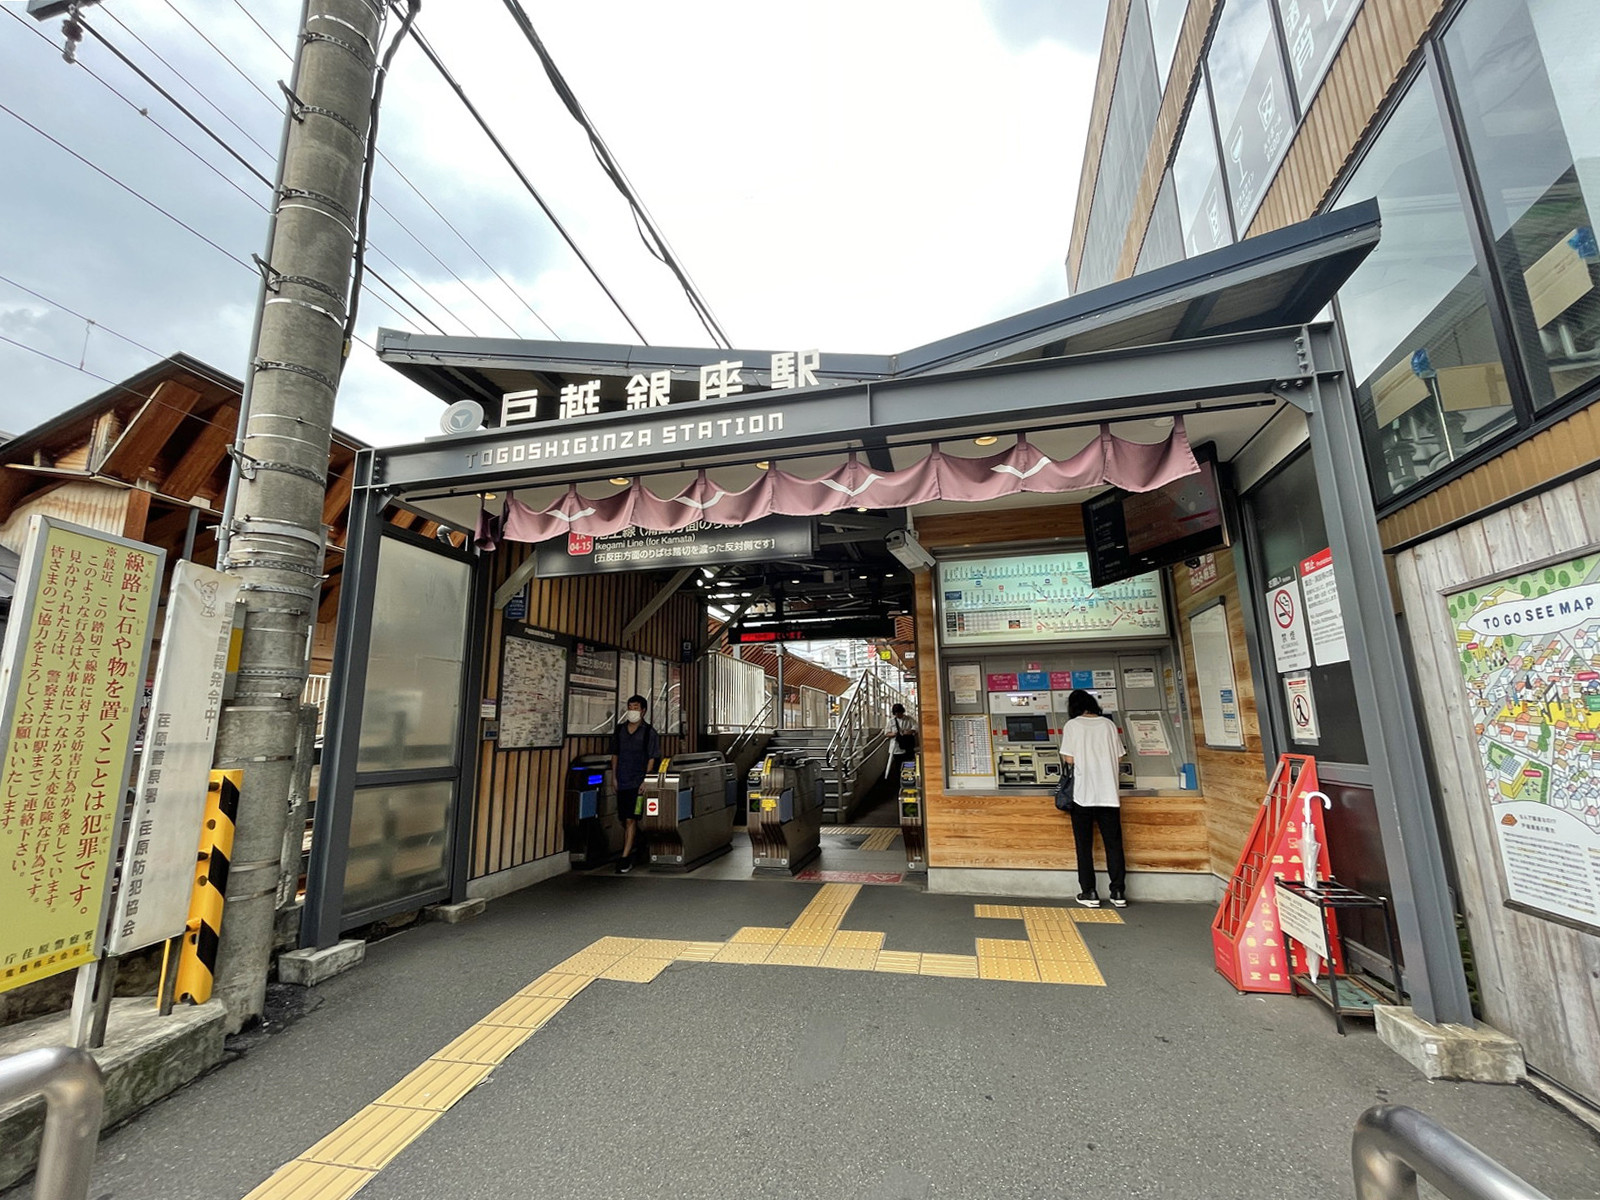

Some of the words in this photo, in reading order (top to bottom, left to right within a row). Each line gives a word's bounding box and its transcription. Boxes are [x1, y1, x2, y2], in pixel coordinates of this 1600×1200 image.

[500, 348, 821, 428] 戸越銀座駅
[464, 428, 653, 469] TOGOSHIGINZA
[661, 411, 785, 446] STATION
[569, 541, 592, 551] 04-15
[595, 540, 625, 552] Ikegami
[627, 539, 644, 548] Line
[646, 537, 659, 547] (for
[661, 533, 696, 546] Kamata)
[1483, 616, 1500, 629] TO
[1503, 611, 1521, 626] GO
[1524, 604, 1555, 623] SEE
[1558, 597, 1595, 616] MAP
[0, 544, 65, 835] 皆さまのご協力をよろしくお願いいたします。
[69, 552, 145, 915] 線路に石や物を置くことは犯罪です。
